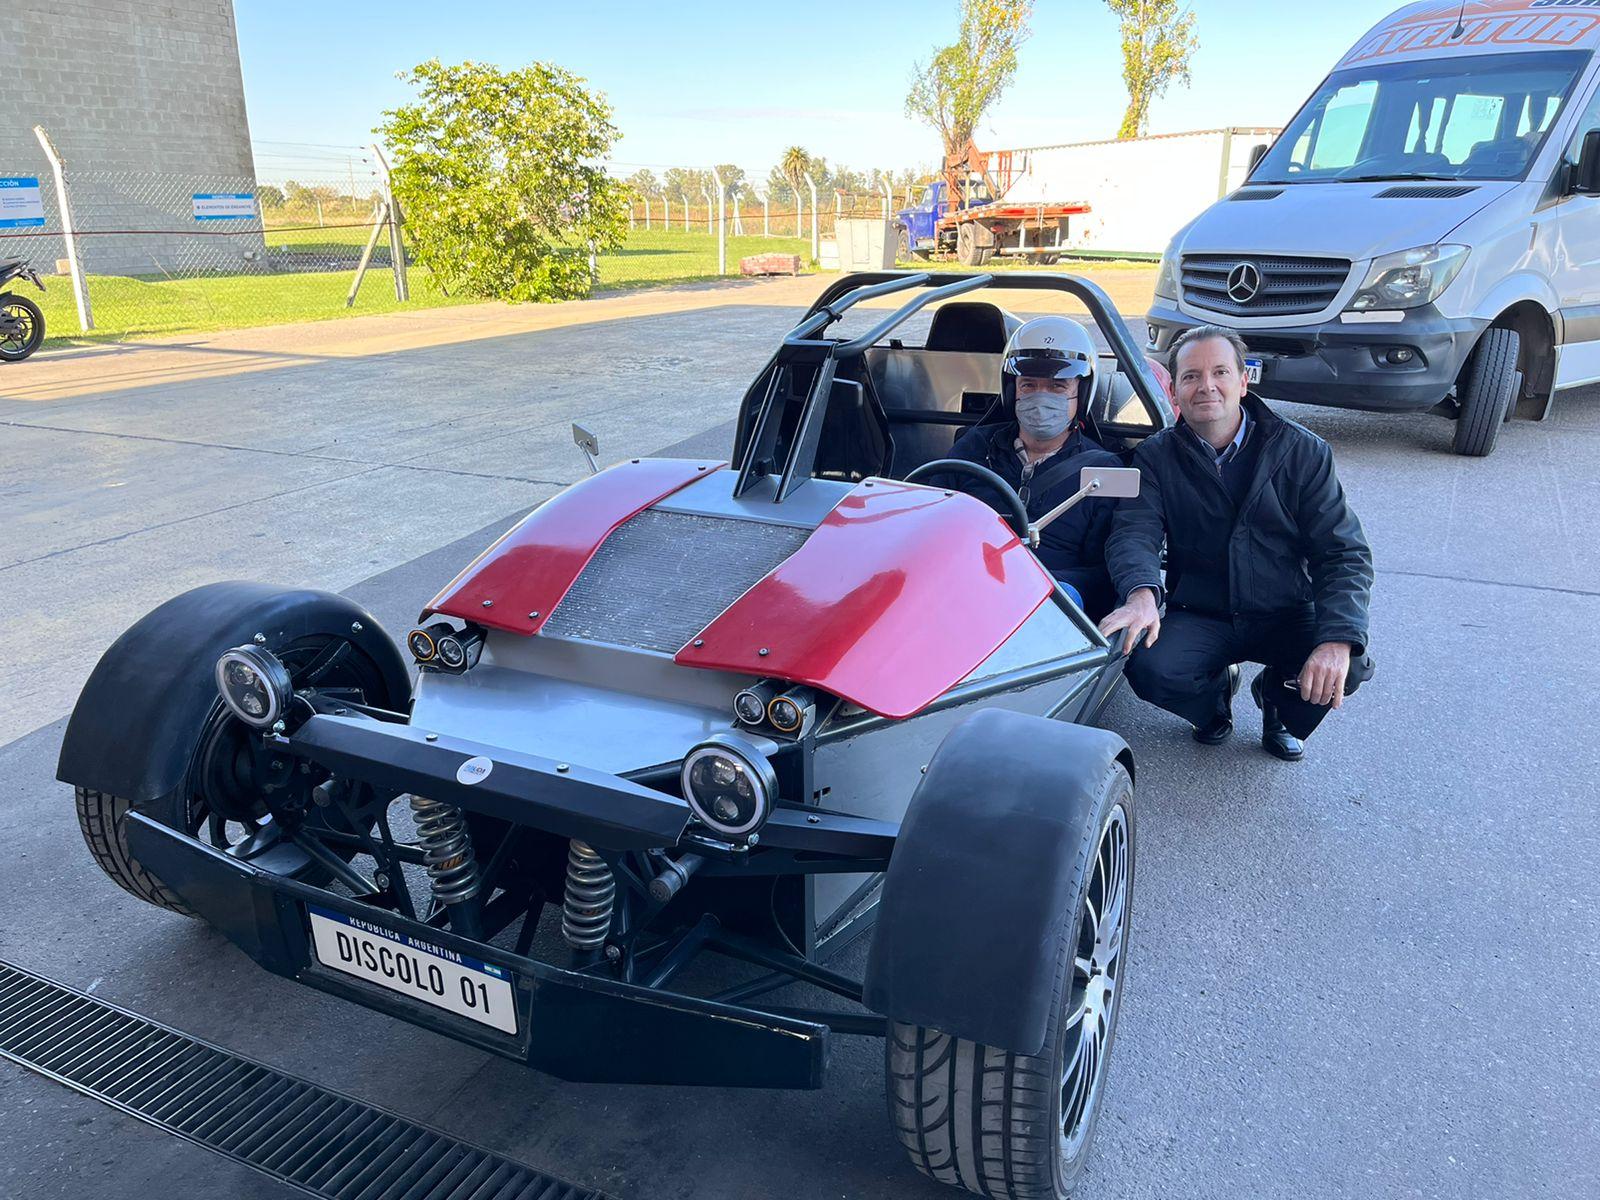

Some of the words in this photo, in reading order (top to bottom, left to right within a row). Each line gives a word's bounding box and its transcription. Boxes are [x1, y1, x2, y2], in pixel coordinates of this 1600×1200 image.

[336, 931, 445, 996] DISCOLO
[460, 976, 490, 1014] 01
[408, 937, 462, 963] ARGENTINA
